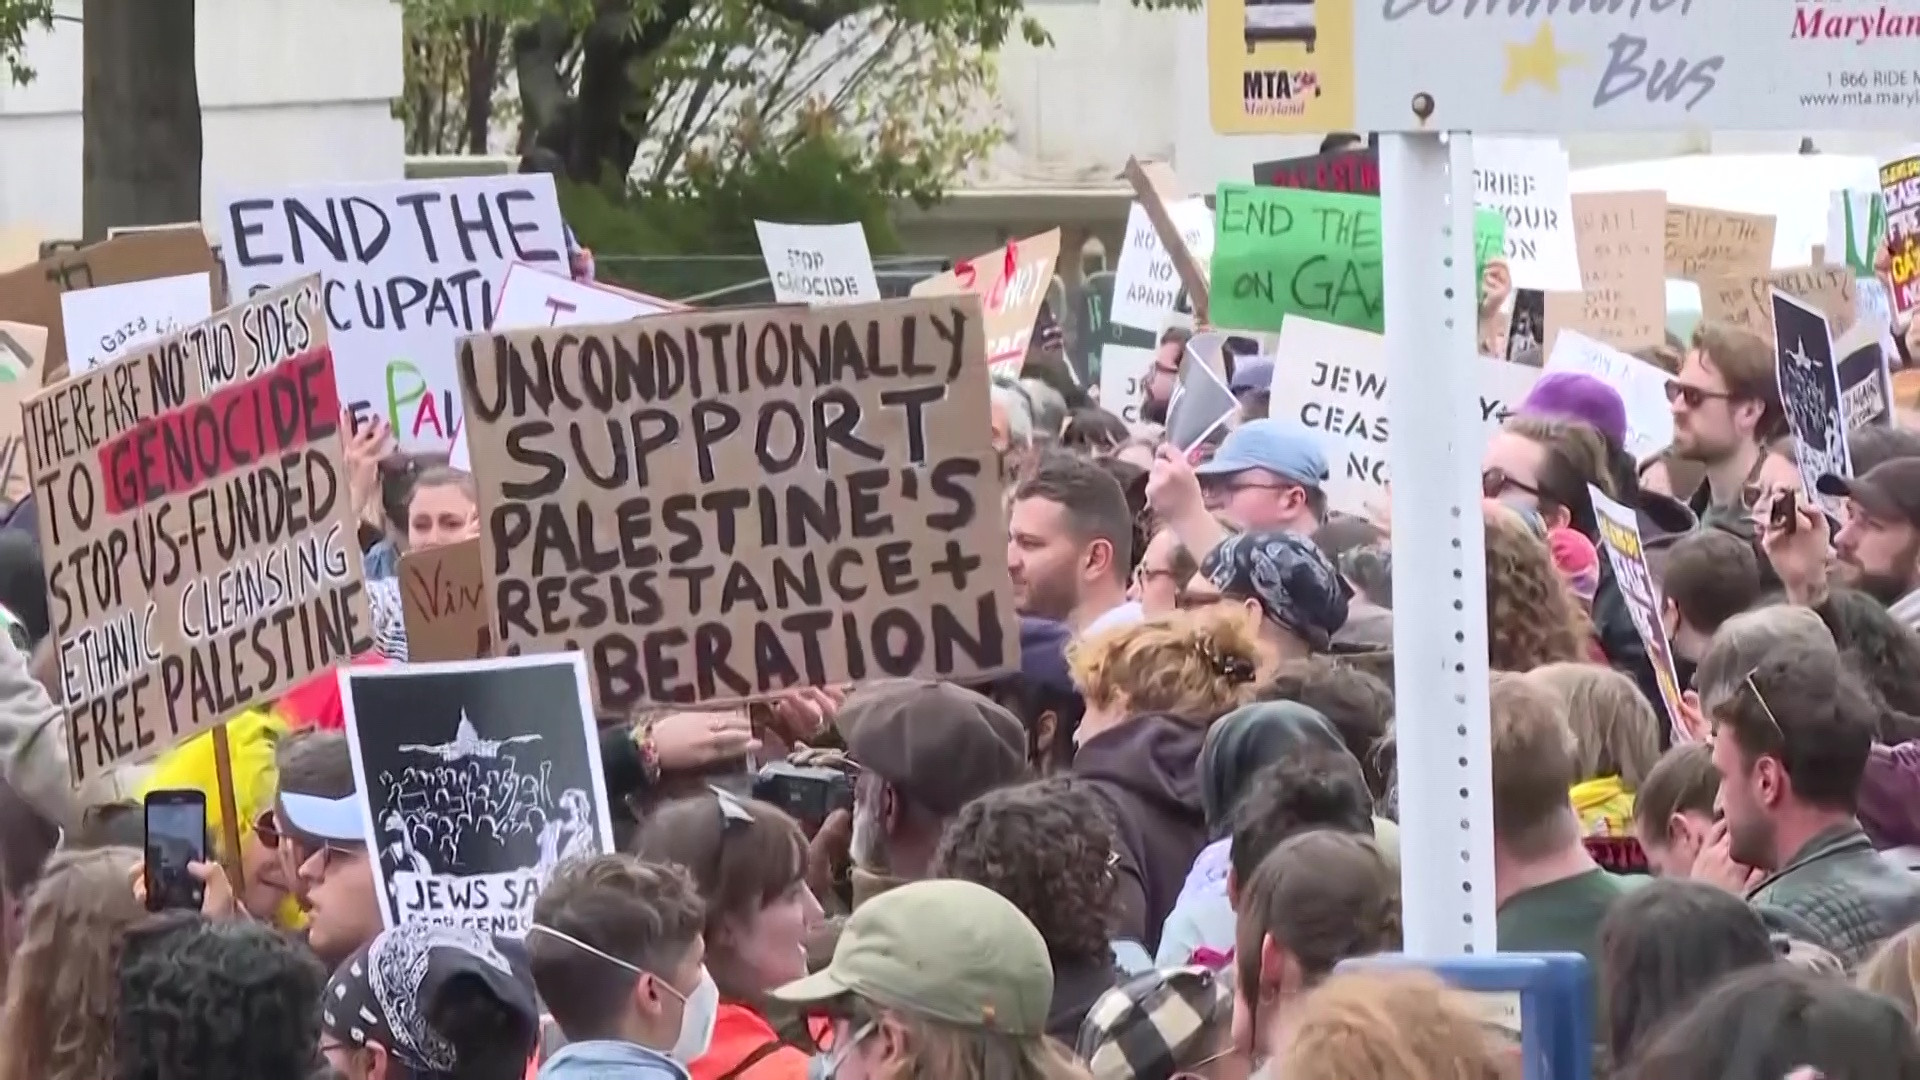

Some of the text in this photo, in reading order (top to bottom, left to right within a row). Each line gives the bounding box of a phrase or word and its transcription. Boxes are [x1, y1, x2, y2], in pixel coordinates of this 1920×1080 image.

[1244, 71, 1292, 100] MTA
[1593, 33, 1725, 112] Bus
[1873, 69, 1908, 87] RIDE
[229, 189, 561, 266] END THE
[1222, 189, 1378, 248] END THE
[248, 270, 496, 332] CUPATI
[1233, 271, 1274, 305] ON
[100, 315, 148, 353] Gaza
[461, 308, 969, 422] UNCONDITIONALLY
[28, 378, 101, 470] THERE
[102, 359, 142, 440] ARE
[148, 341, 186, 420] NO
[1311, 362, 1387, 400] JEW
[36, 360, 338, 545] TO GENOCIDE
[502, 385, 948, 500] SUPPORT
[49, 448, 338, 638] STOP US-FUNDED
[491, 457, 983, 578] PALESTINE'S
[61, 522, 347, 704] ETHNIC CLEANSING
[497, 540, 919, 639] RESISTANCE
[70, 582, 374, 782] FREE PALESTINE
[506, 591, 1004, 701] BERATION
[406, 878, 540, 910] JEWS SA
